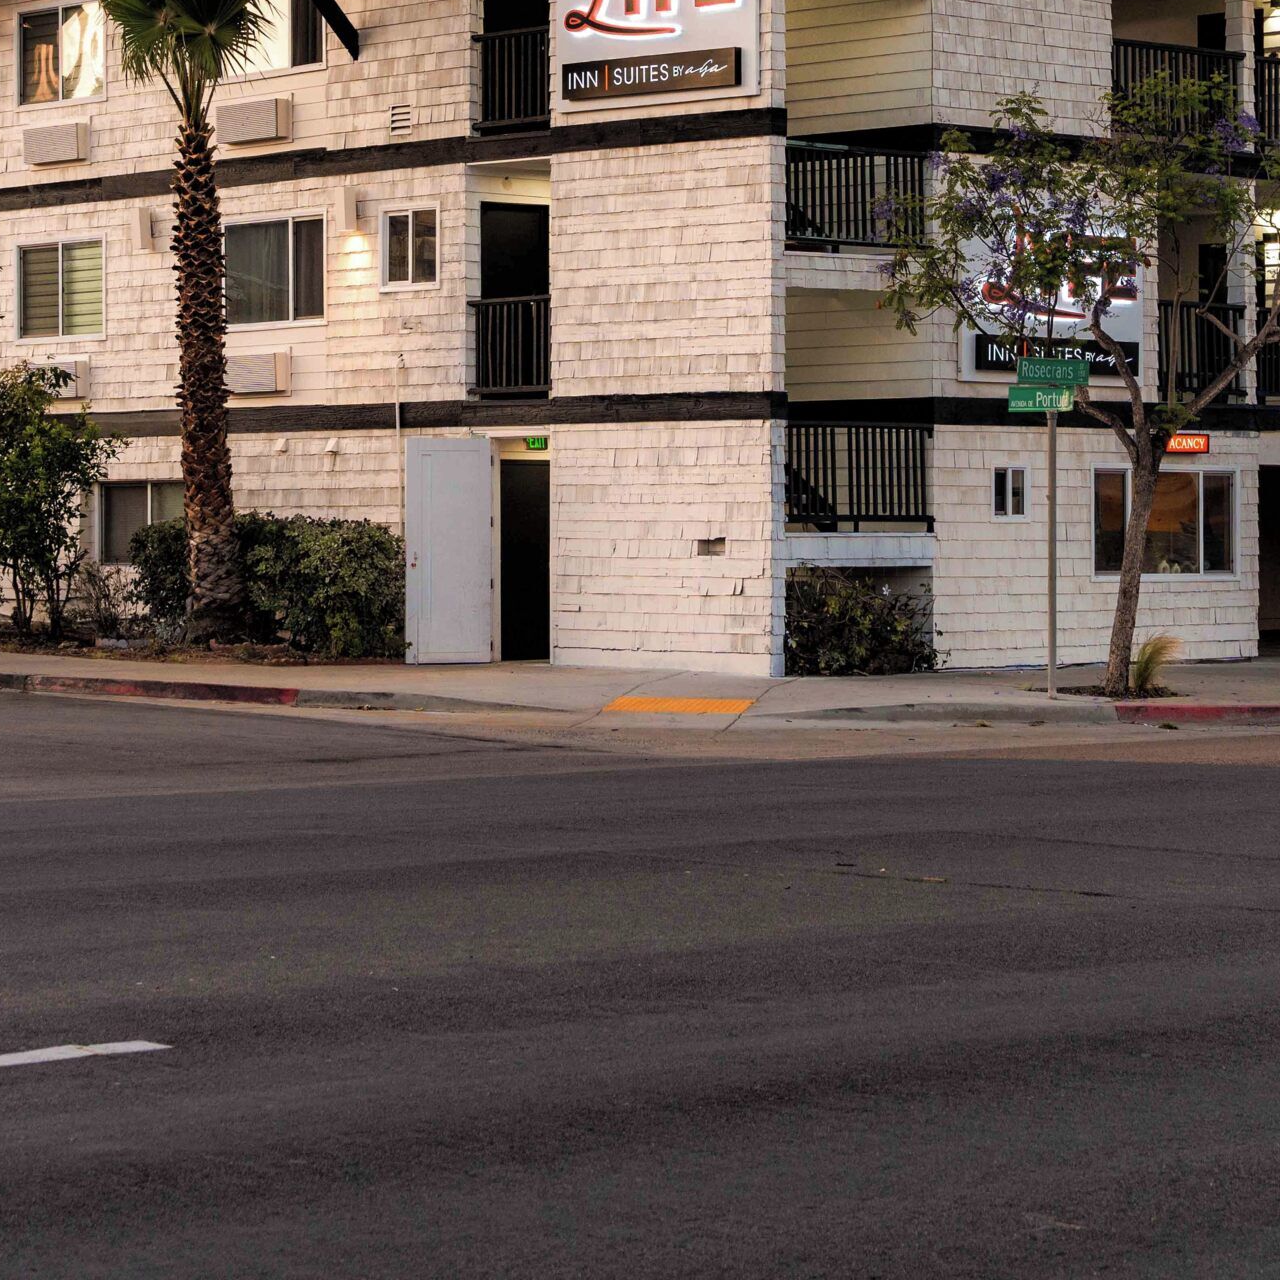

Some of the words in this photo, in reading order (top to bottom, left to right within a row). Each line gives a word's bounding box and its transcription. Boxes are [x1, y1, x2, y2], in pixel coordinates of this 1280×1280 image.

[568, 70, 598, 90] INN
[613, 63, 669, 85] SUITES
[673, 65, 685, 77] BY
[1022, 361, 1074, 379] Rosecrans
